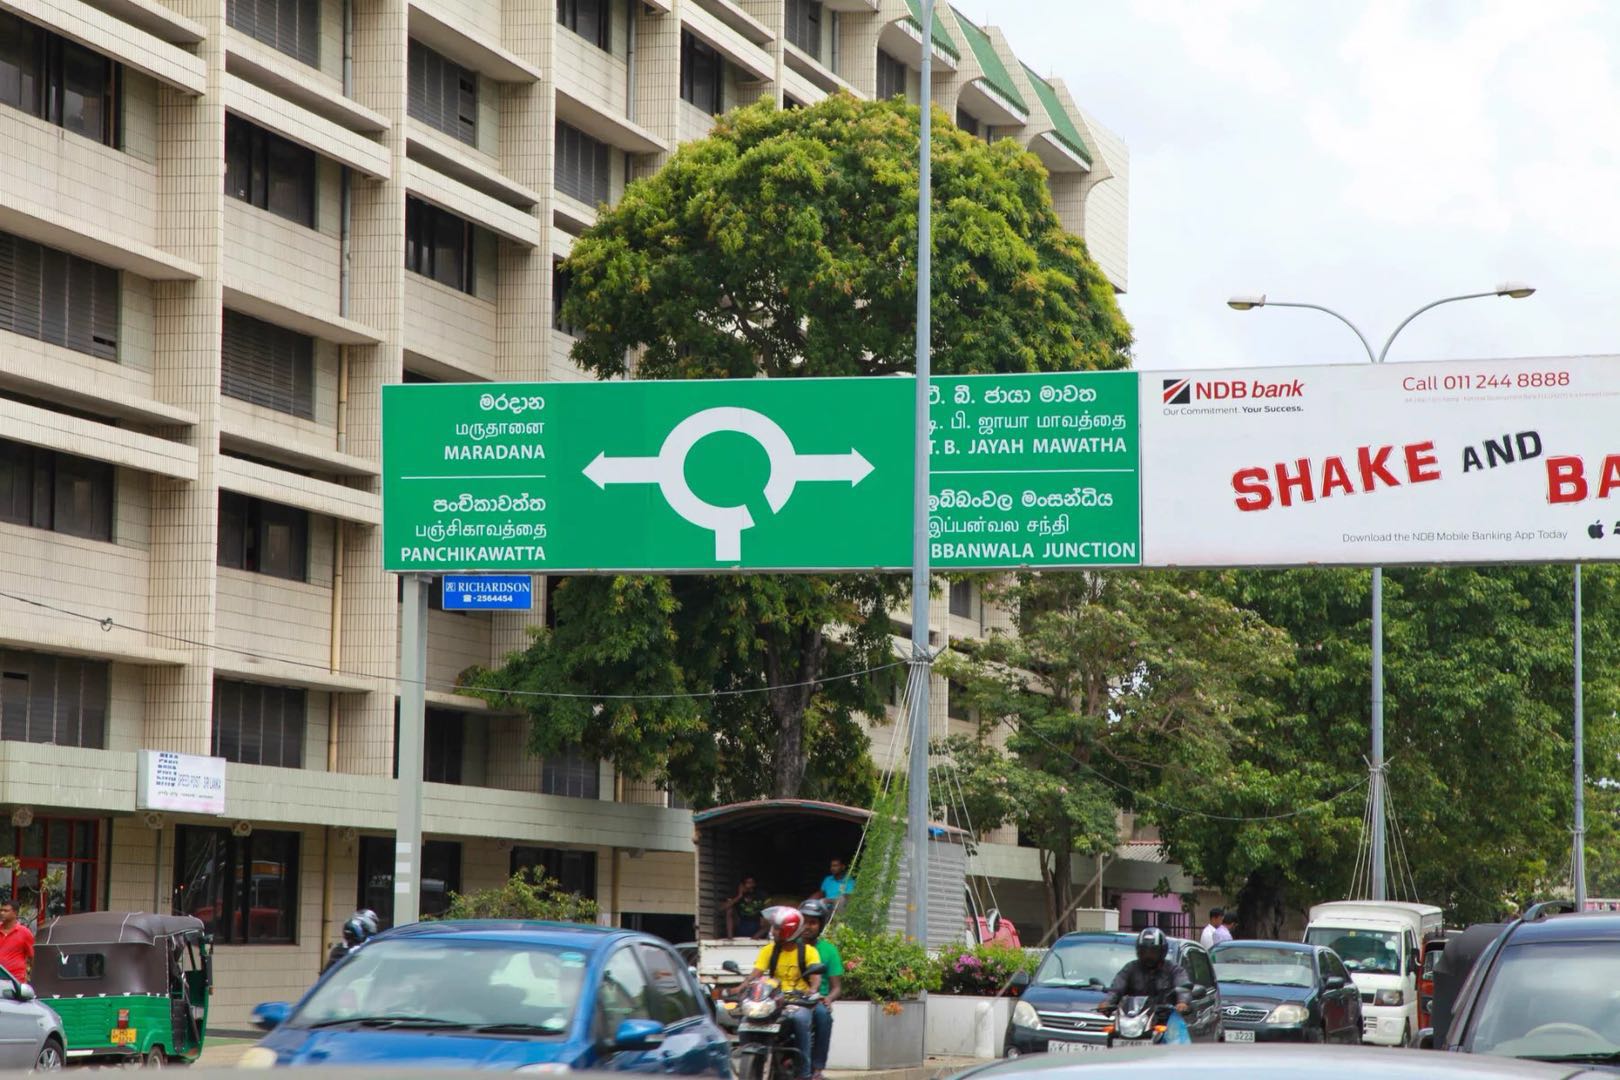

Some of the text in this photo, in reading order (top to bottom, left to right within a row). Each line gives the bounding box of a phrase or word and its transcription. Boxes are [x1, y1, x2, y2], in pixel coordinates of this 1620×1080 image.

[1196, 379, 1304, 399] NDB bank
[1403, 372, 1569, 390] Call 011 244 8888
[984, 387, 1030, 403] ජායා
[1040, 385, 1096, 402] මාවත
[480, 394, 544, 414] මරදාන
[1163, 407, 1178, 416] Our
[1242, 406, 1261, 414] Your
[1265, 405, 1303, 413] Success.
[456, 423, 544, 440] மருதானை
[979, 417, 1028, 434] ஜாயா
[1038, 411, 1125, 431] மாவத்தை
[445, 445, 544, 459] MARADANA
[945, 440, 960, 454] B.
[969, 439, 1023, 454] JAYAH
[1034, 438, 1126, 452] MAWATHA
[1231, 431, 1620, 512] SHAKE AND BA
[434, 493, 545, 512] පංචිකාවත්ත
[416, 519, 546, 541] பஞ்சிகாவத்தை
[1027, 514, 1068, 536] சந்தி
[1343, 530, 1567, 543] Download the NDB Mobile Banking App Today
[401, 546, 545, 561] PANCHIKAWATTA
[932, 542, 1135, 558] BBANWALA JUNCTION
[458, 582, 530, 593] RICHARDSON
